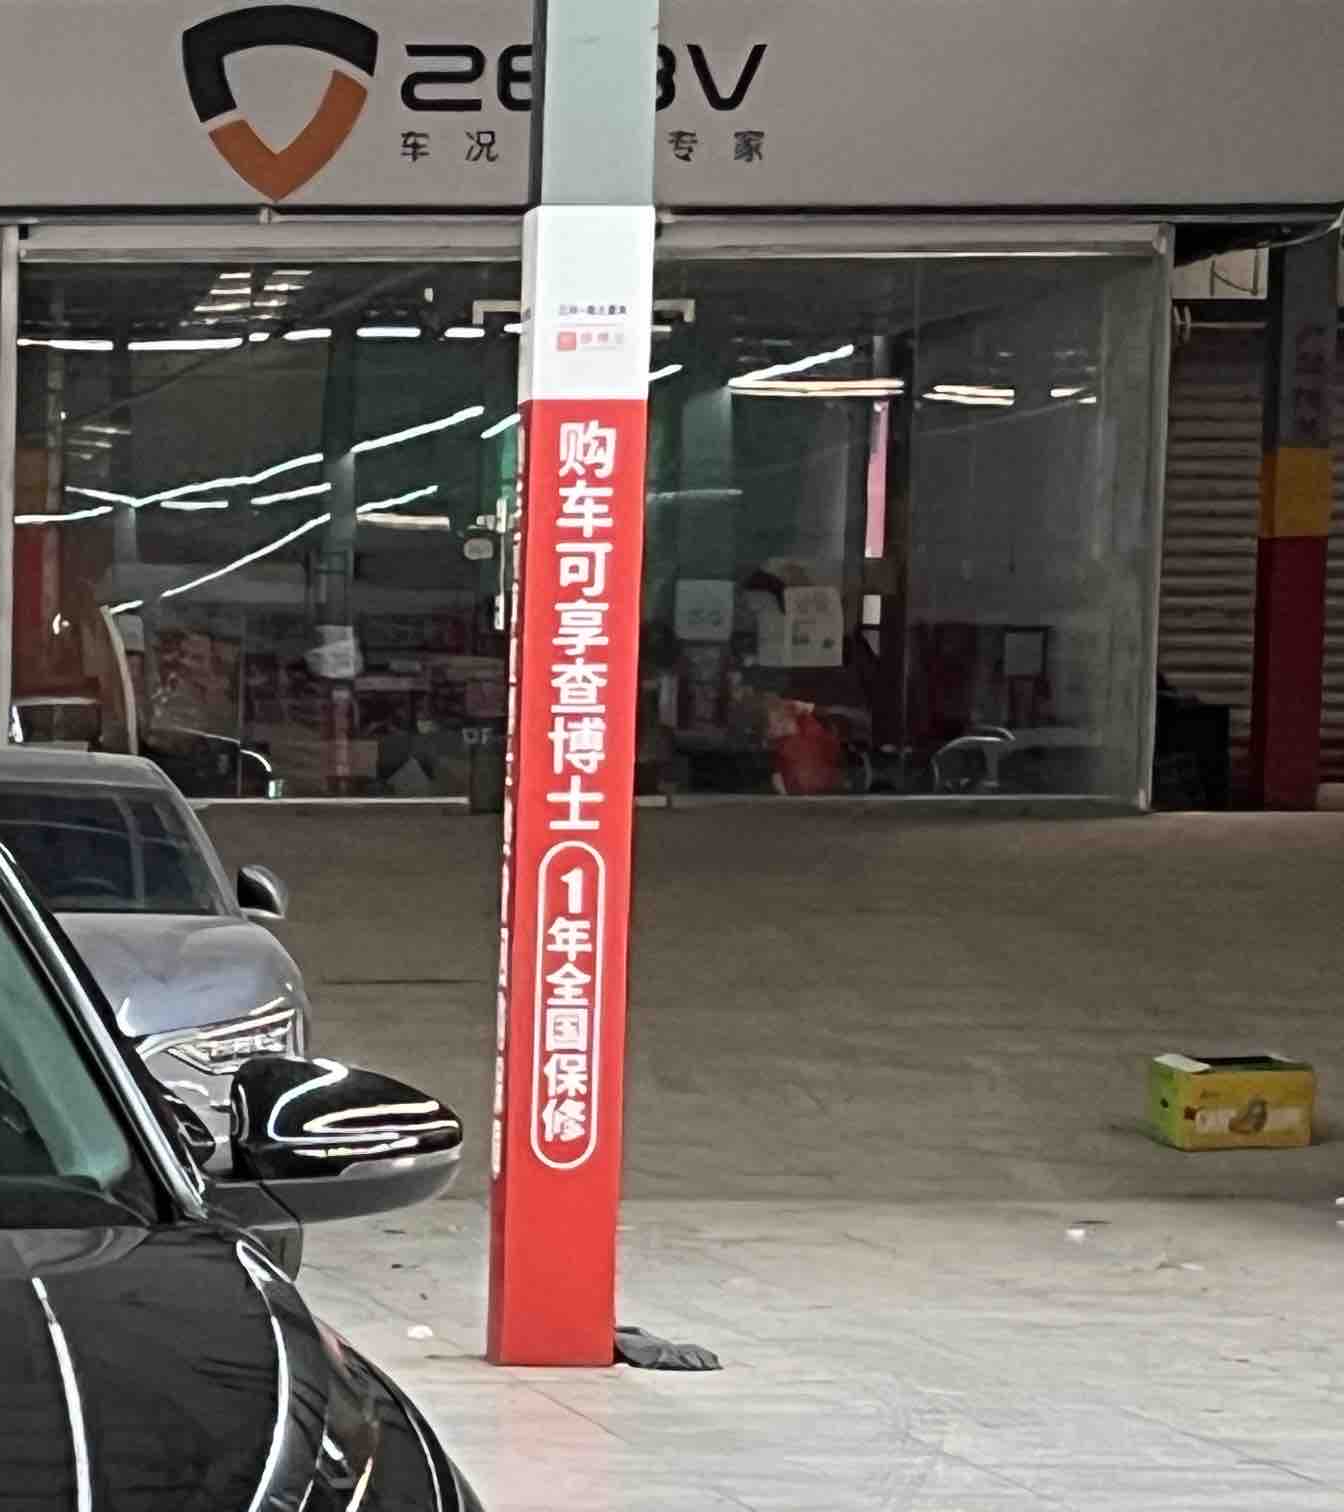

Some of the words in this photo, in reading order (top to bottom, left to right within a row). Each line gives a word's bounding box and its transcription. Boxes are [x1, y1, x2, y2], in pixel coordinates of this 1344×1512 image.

[399, 130, 766, 163] 车况专家
[546, 419, 617, 830] 购车可享查博士
[542, 866, 593, 1142] 1年全国保修
